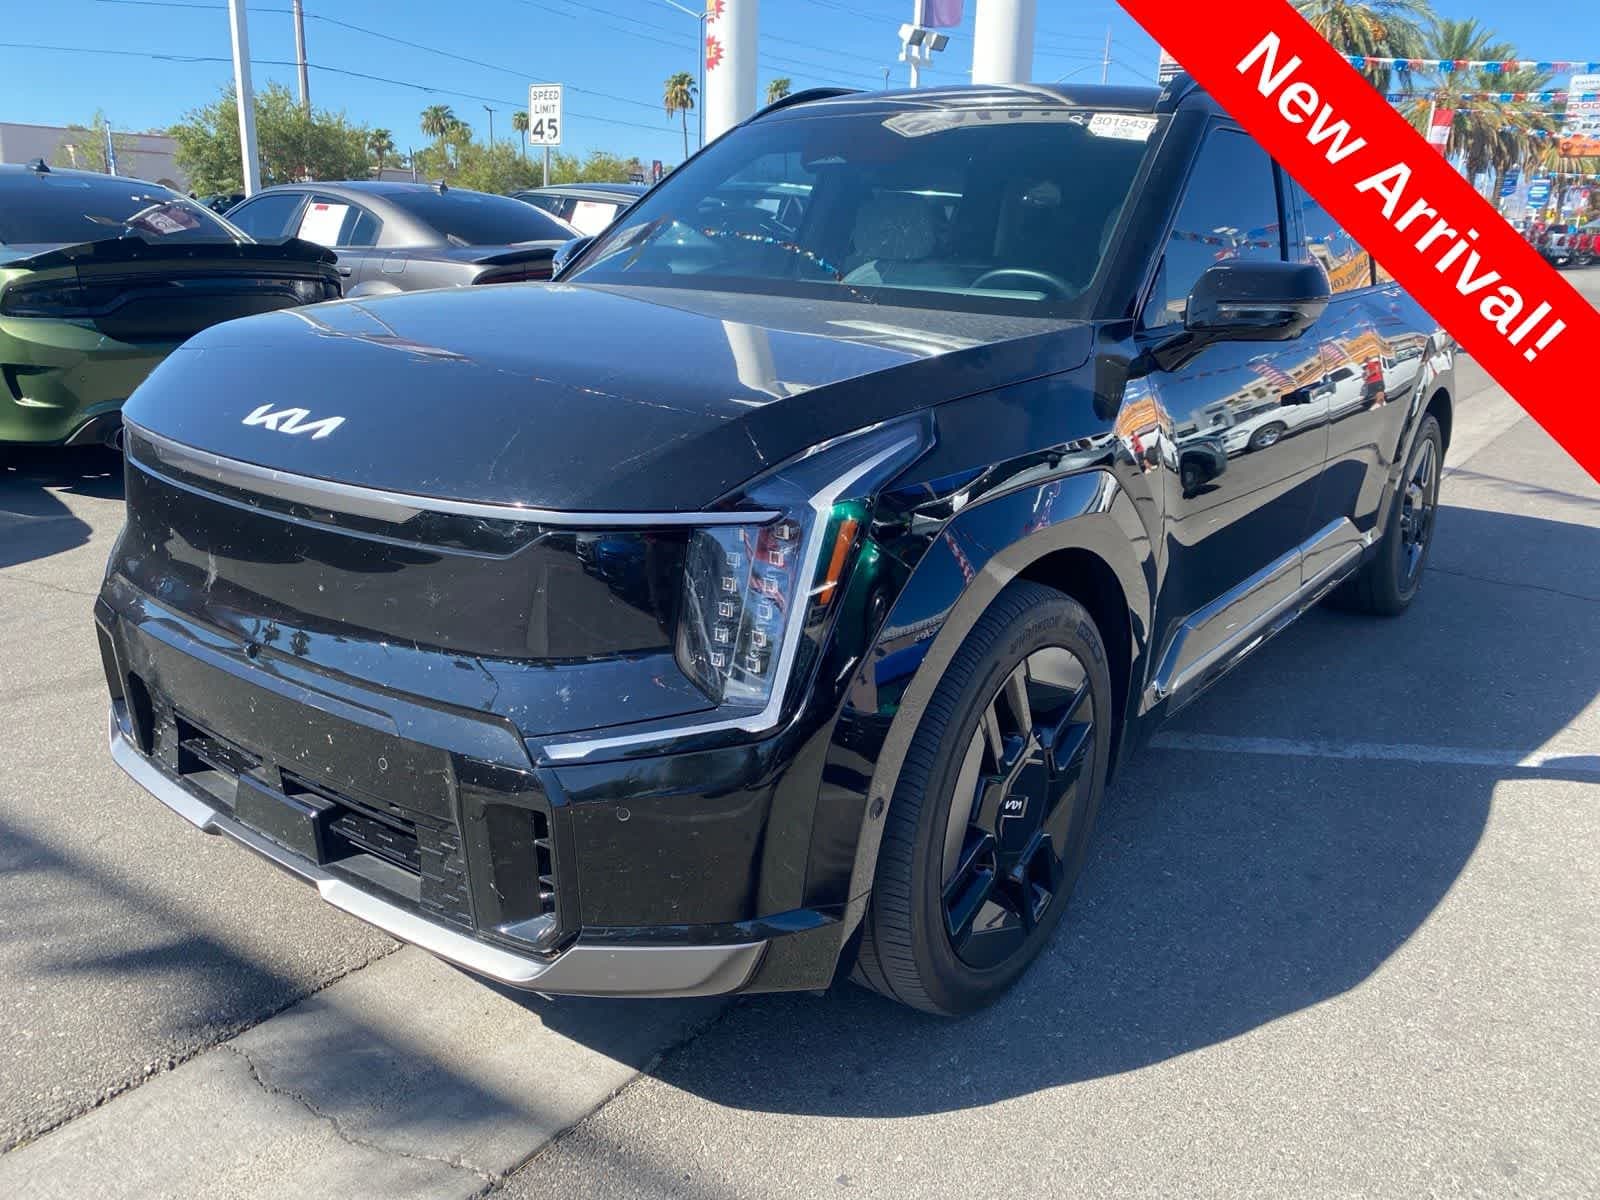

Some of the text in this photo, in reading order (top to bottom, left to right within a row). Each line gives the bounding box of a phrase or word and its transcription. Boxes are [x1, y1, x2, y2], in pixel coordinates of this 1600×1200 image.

[533, 90, 559, 101] SPEED
[534, 103, 556, 114] LIMIT
[532, 118, 558, 140] 45
[241, 403, 346, 440] KIA
